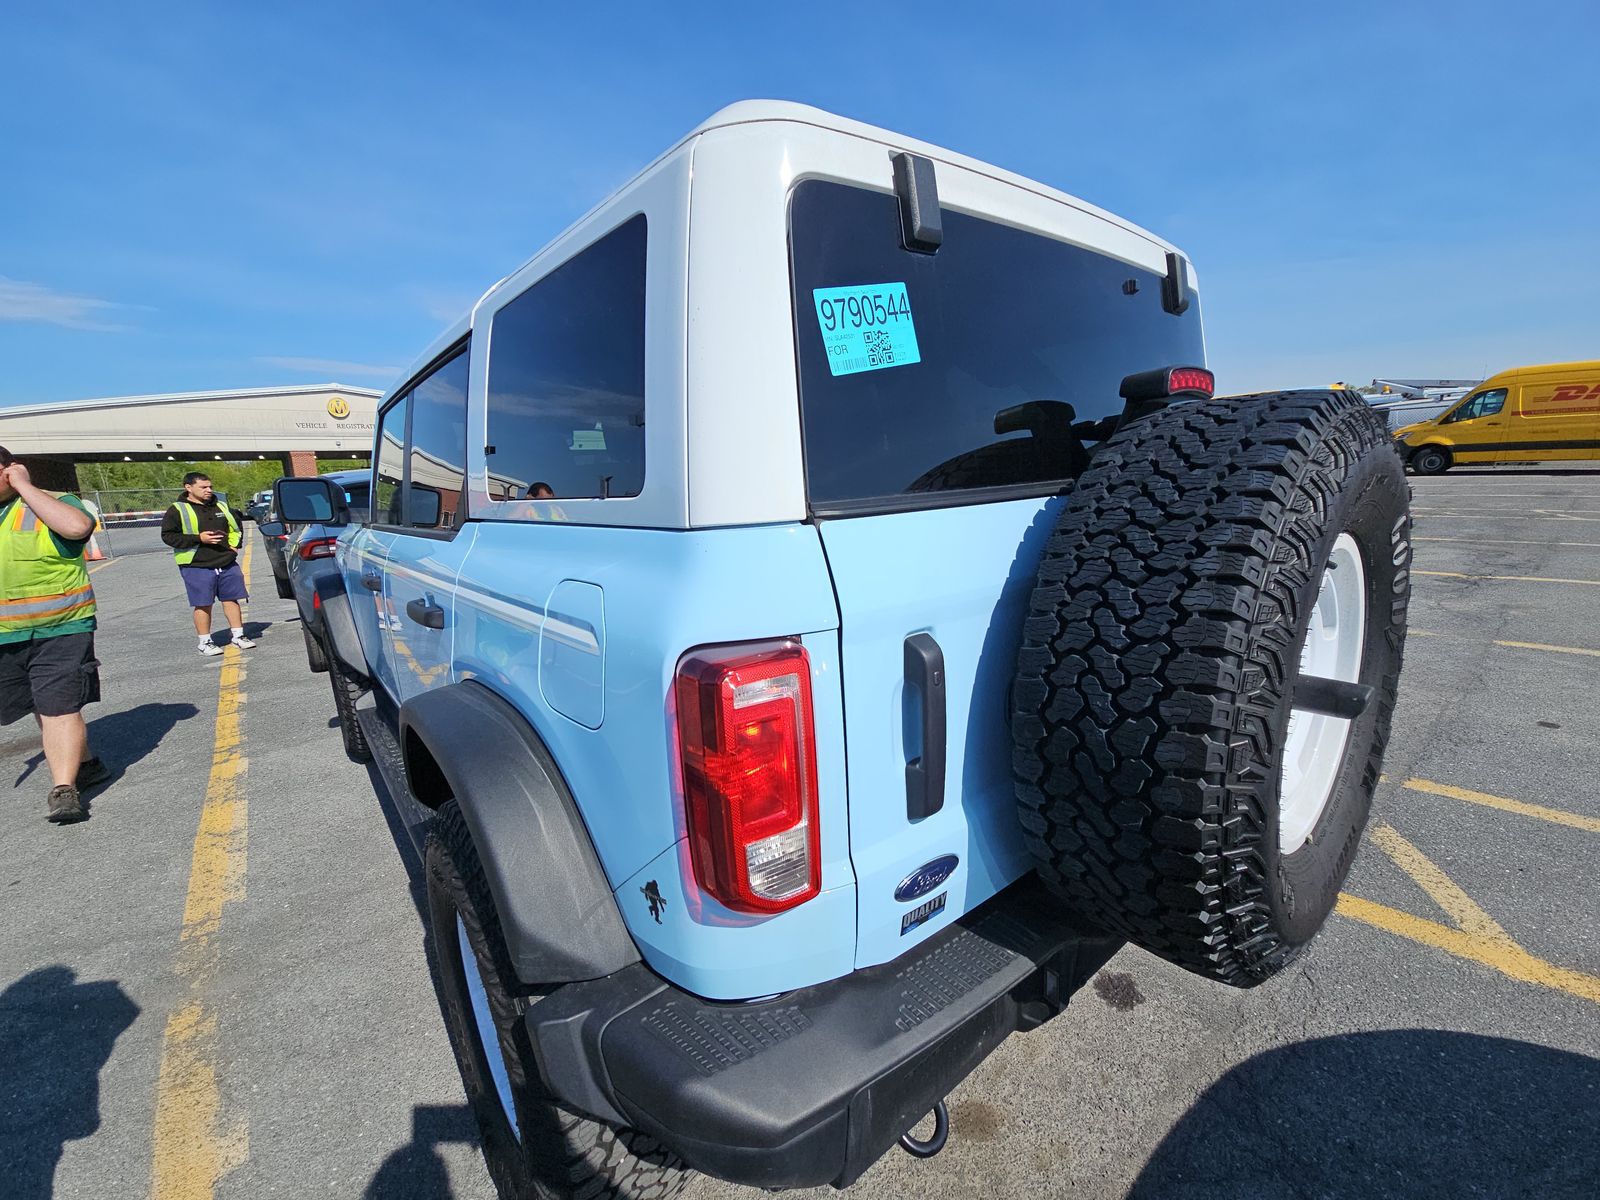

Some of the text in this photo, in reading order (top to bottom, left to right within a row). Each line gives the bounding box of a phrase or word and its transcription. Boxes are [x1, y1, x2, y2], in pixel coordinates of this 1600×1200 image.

[820, 292, 910, 331] 9790544
[827, 344, 849, 355] FOR
[902, 892, 948, 928] QUALITY
